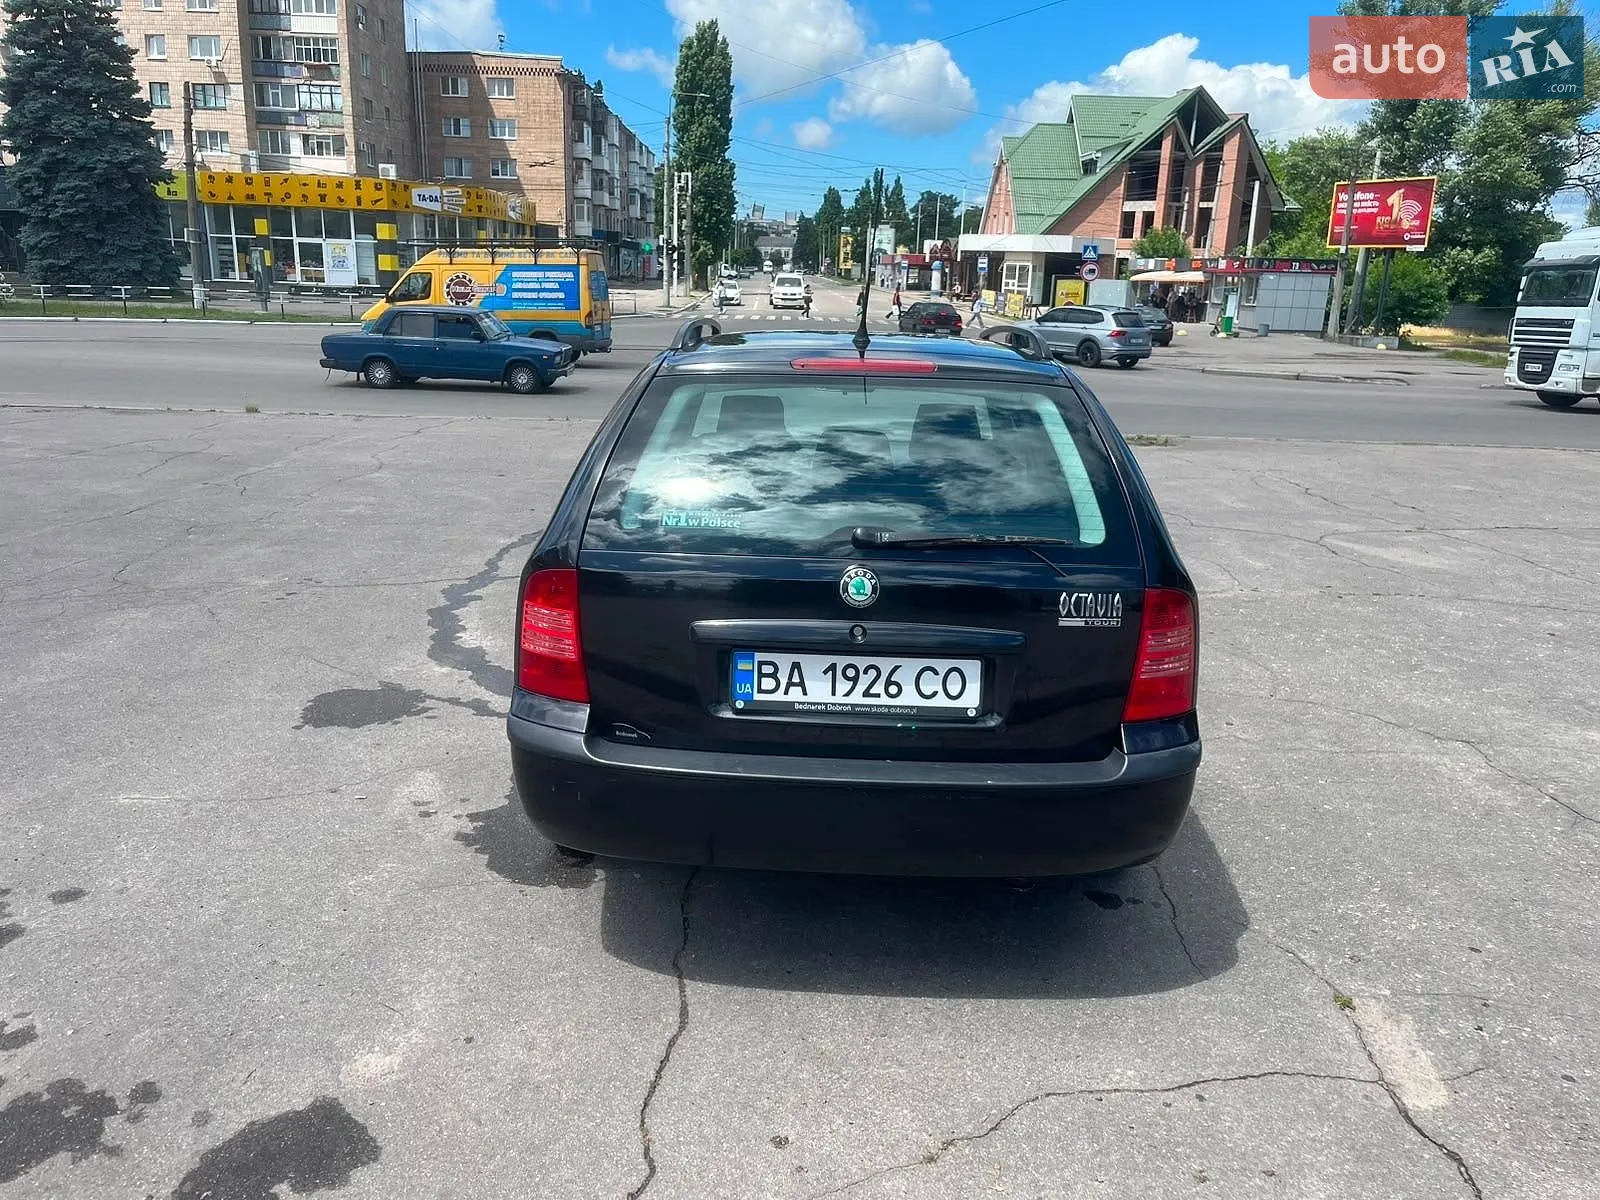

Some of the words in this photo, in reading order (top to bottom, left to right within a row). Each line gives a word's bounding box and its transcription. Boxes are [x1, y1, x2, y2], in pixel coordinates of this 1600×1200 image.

[688, 518, 699, 527] w
[701, 516, 741, 528] Polsce
[1058, 591, 1123, 617] OCTAVIA
[757, 660, 808, 696] BA
[822, 662, 903, 699] 1926
[914, 666, 967, 701] CO
[736, 683, 752, 694] UA
[794, 702, 826, 711] Bednarek
[827, 703, 852, 712] Dobroń
